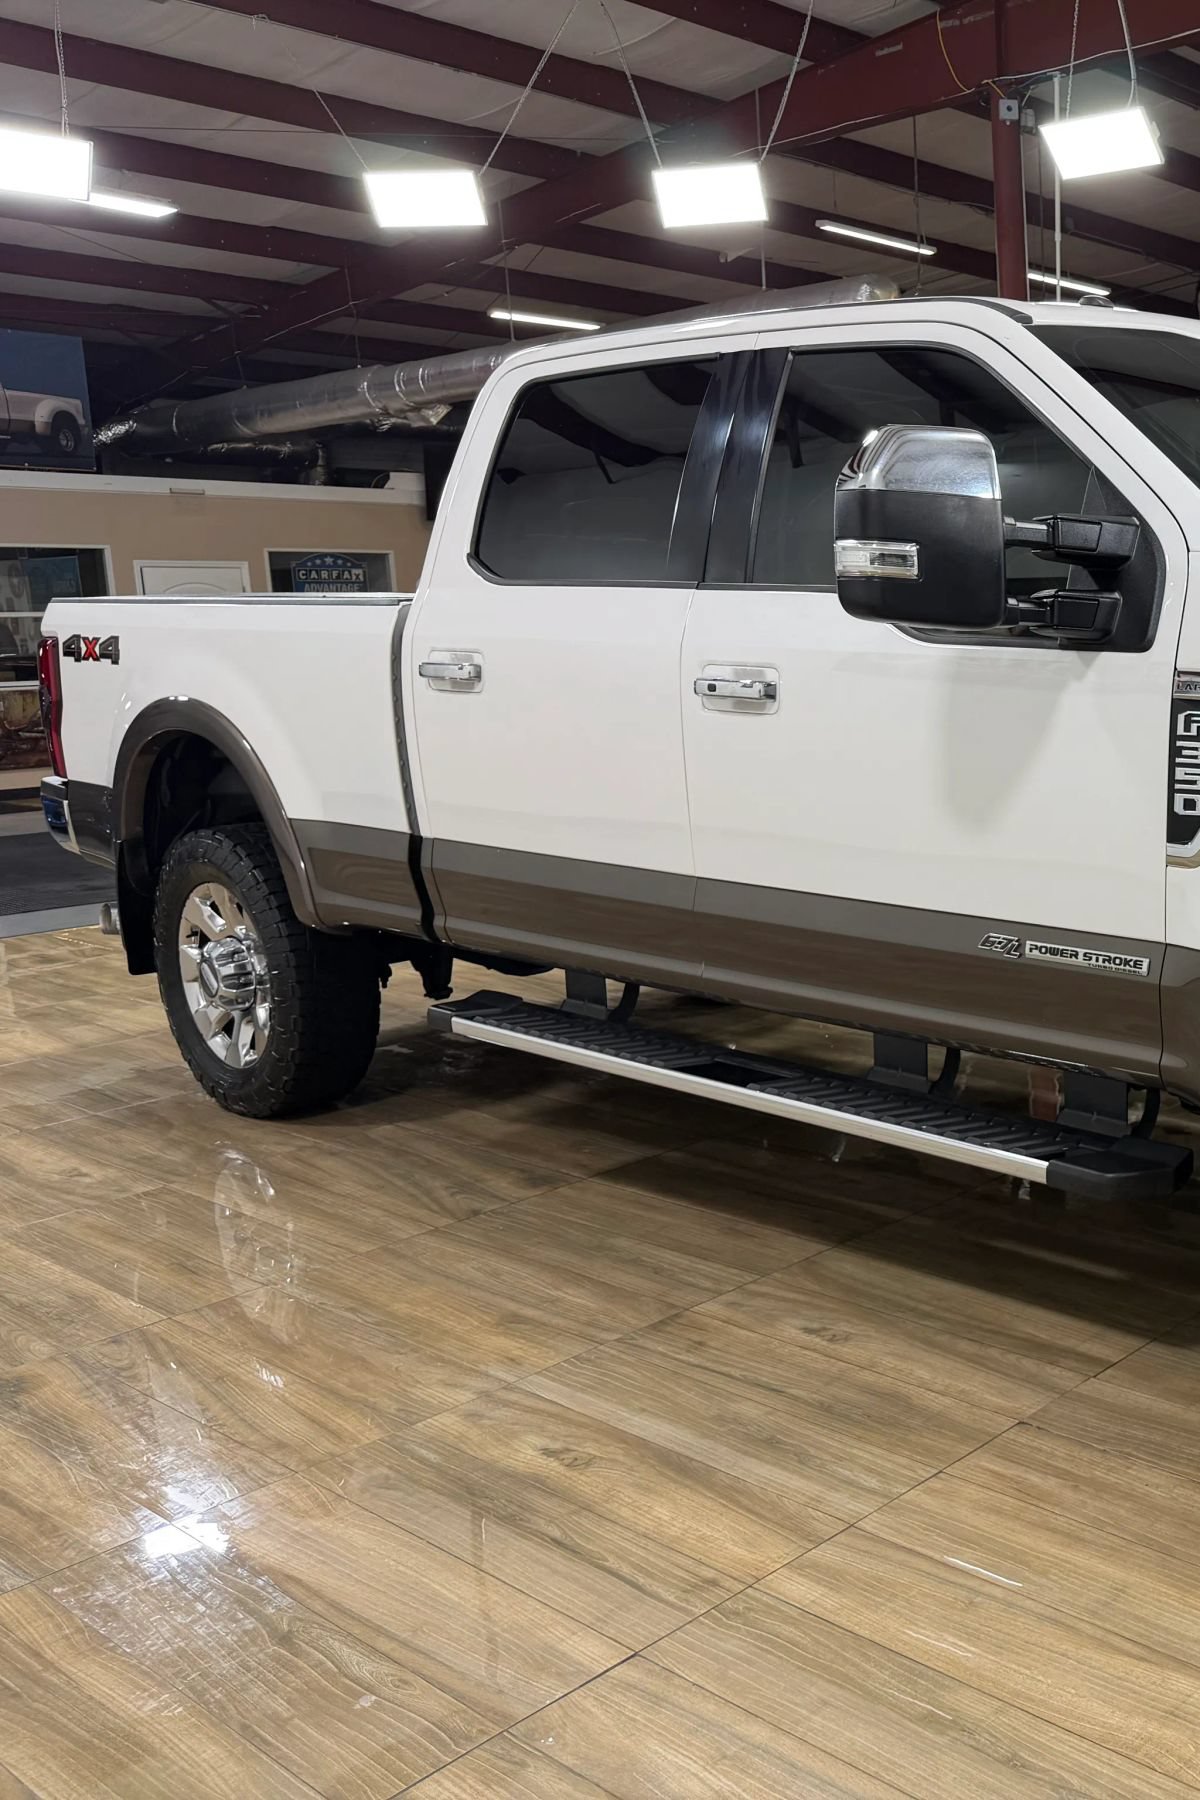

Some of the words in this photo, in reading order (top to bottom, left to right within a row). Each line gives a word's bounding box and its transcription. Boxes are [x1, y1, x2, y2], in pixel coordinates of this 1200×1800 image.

[297, 569, 364, 581] CARFAX
[304, 583, 360, 592] ADVANTAGE
[1029, 943, 1078, 960] POWER
[1082, 952, 1144, 970] STROKE
[1088, 963, 1113, 971] TURBO
